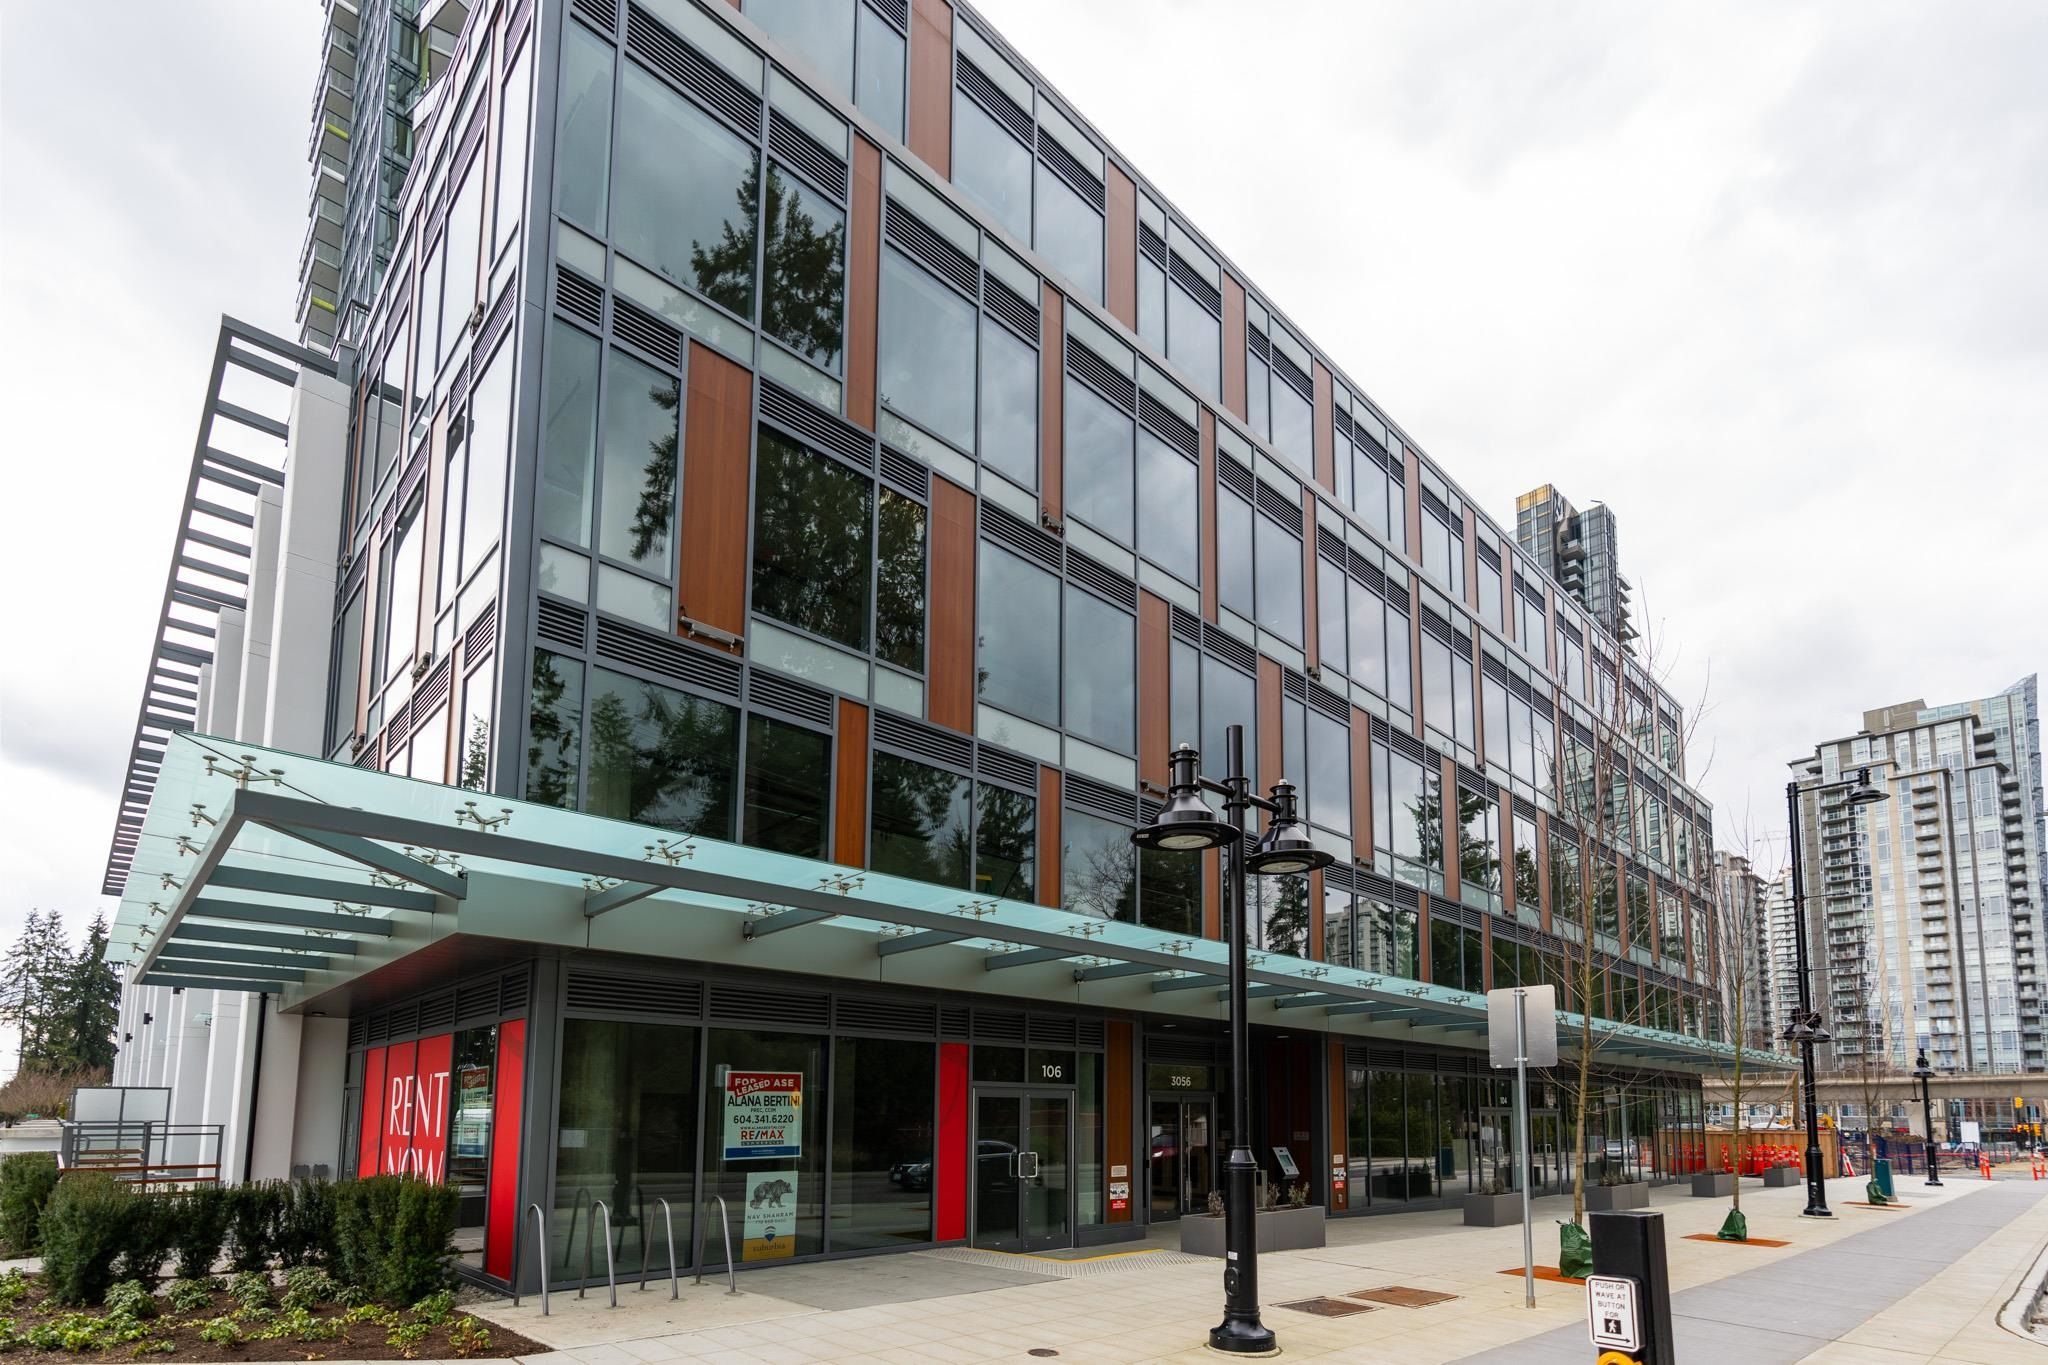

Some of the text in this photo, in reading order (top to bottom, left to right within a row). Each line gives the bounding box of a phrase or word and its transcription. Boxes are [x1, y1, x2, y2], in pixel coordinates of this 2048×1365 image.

[1041, 1065, 1062, 1078] 106
[1171, 1076, 1191, 1086] 3056
[736, 1080, 771, 1096] LEASED
[389, 1072, 450, 1138] RENT
[727, 1096, 800, 1107] ALANA BERTINI
[733, 1115, 794, 1124] 604.341.6220
[741, 1130, 785, 1140] RE/MAX
[1598, 1301, 1625, 1310] BUTTON
